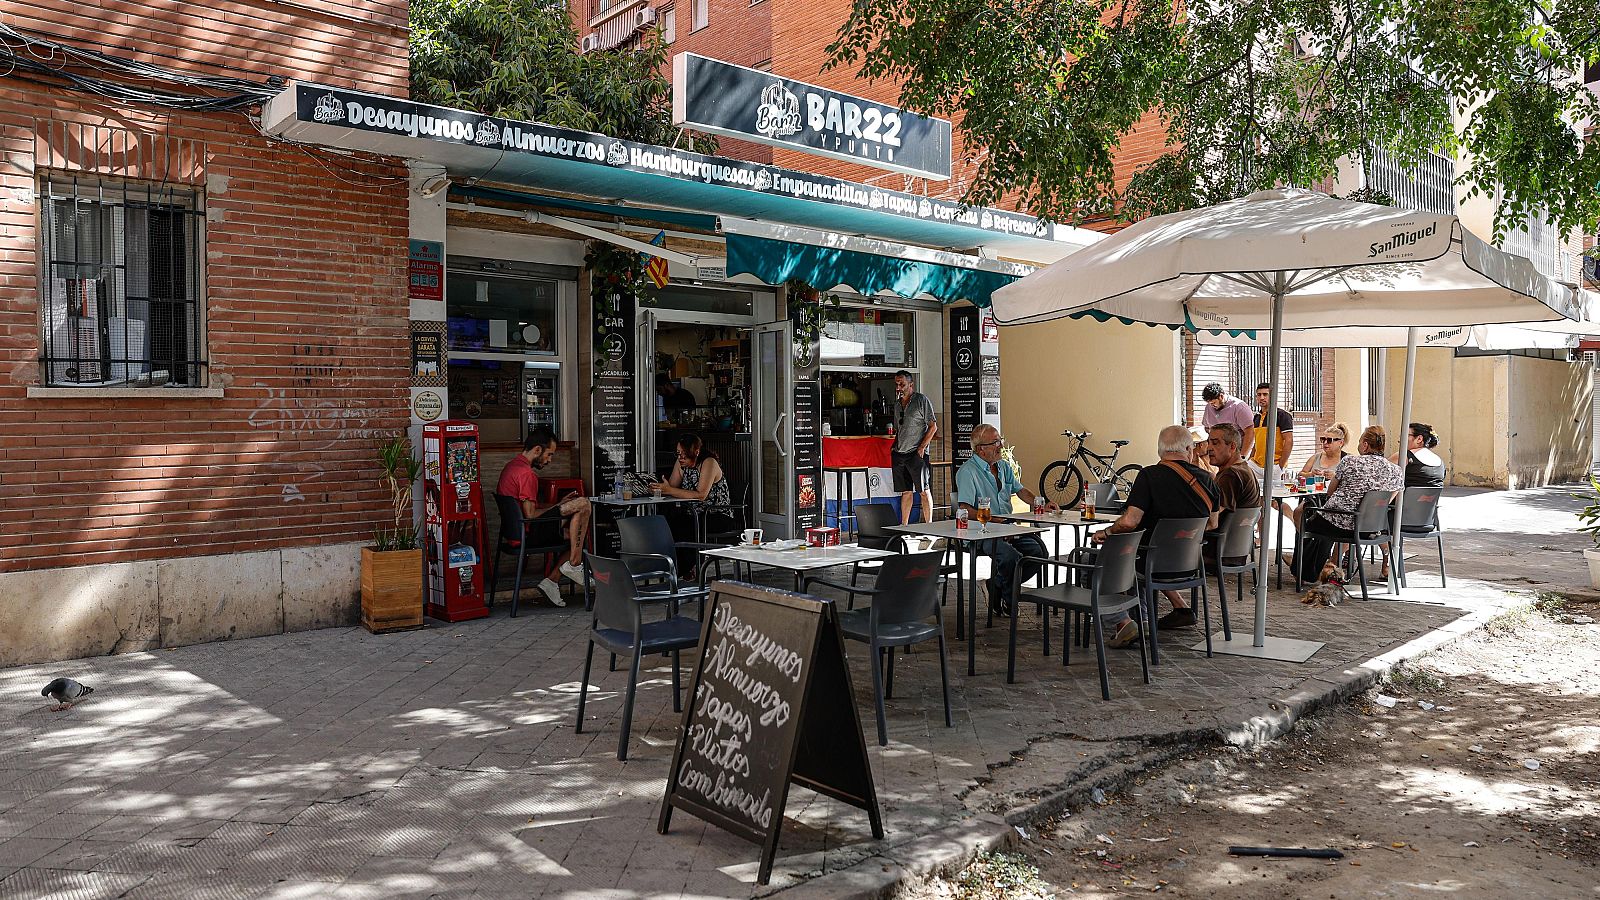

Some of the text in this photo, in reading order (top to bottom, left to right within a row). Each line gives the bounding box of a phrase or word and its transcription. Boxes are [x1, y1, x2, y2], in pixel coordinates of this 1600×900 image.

[806, 92, 901, 147] BAR22
[346, 101, 474, 141] Desayunos
[502, 125, 605, 162] Almuerzos
[630, 147, 755, 185] Hamburguesas
[773, 173, 868, 206] Empanadillas
[883, 193, 917, 214] Tapas
[1368, 221, 1437, 258] SanMiguel
[957, 335, 971, 344] BAR
[959, 353, 970, 363] 22
[714, 602, 802, 682] Desayunos
[697, 680, 752, 743] Tapas
[692, 724, 749, 777] Platos
